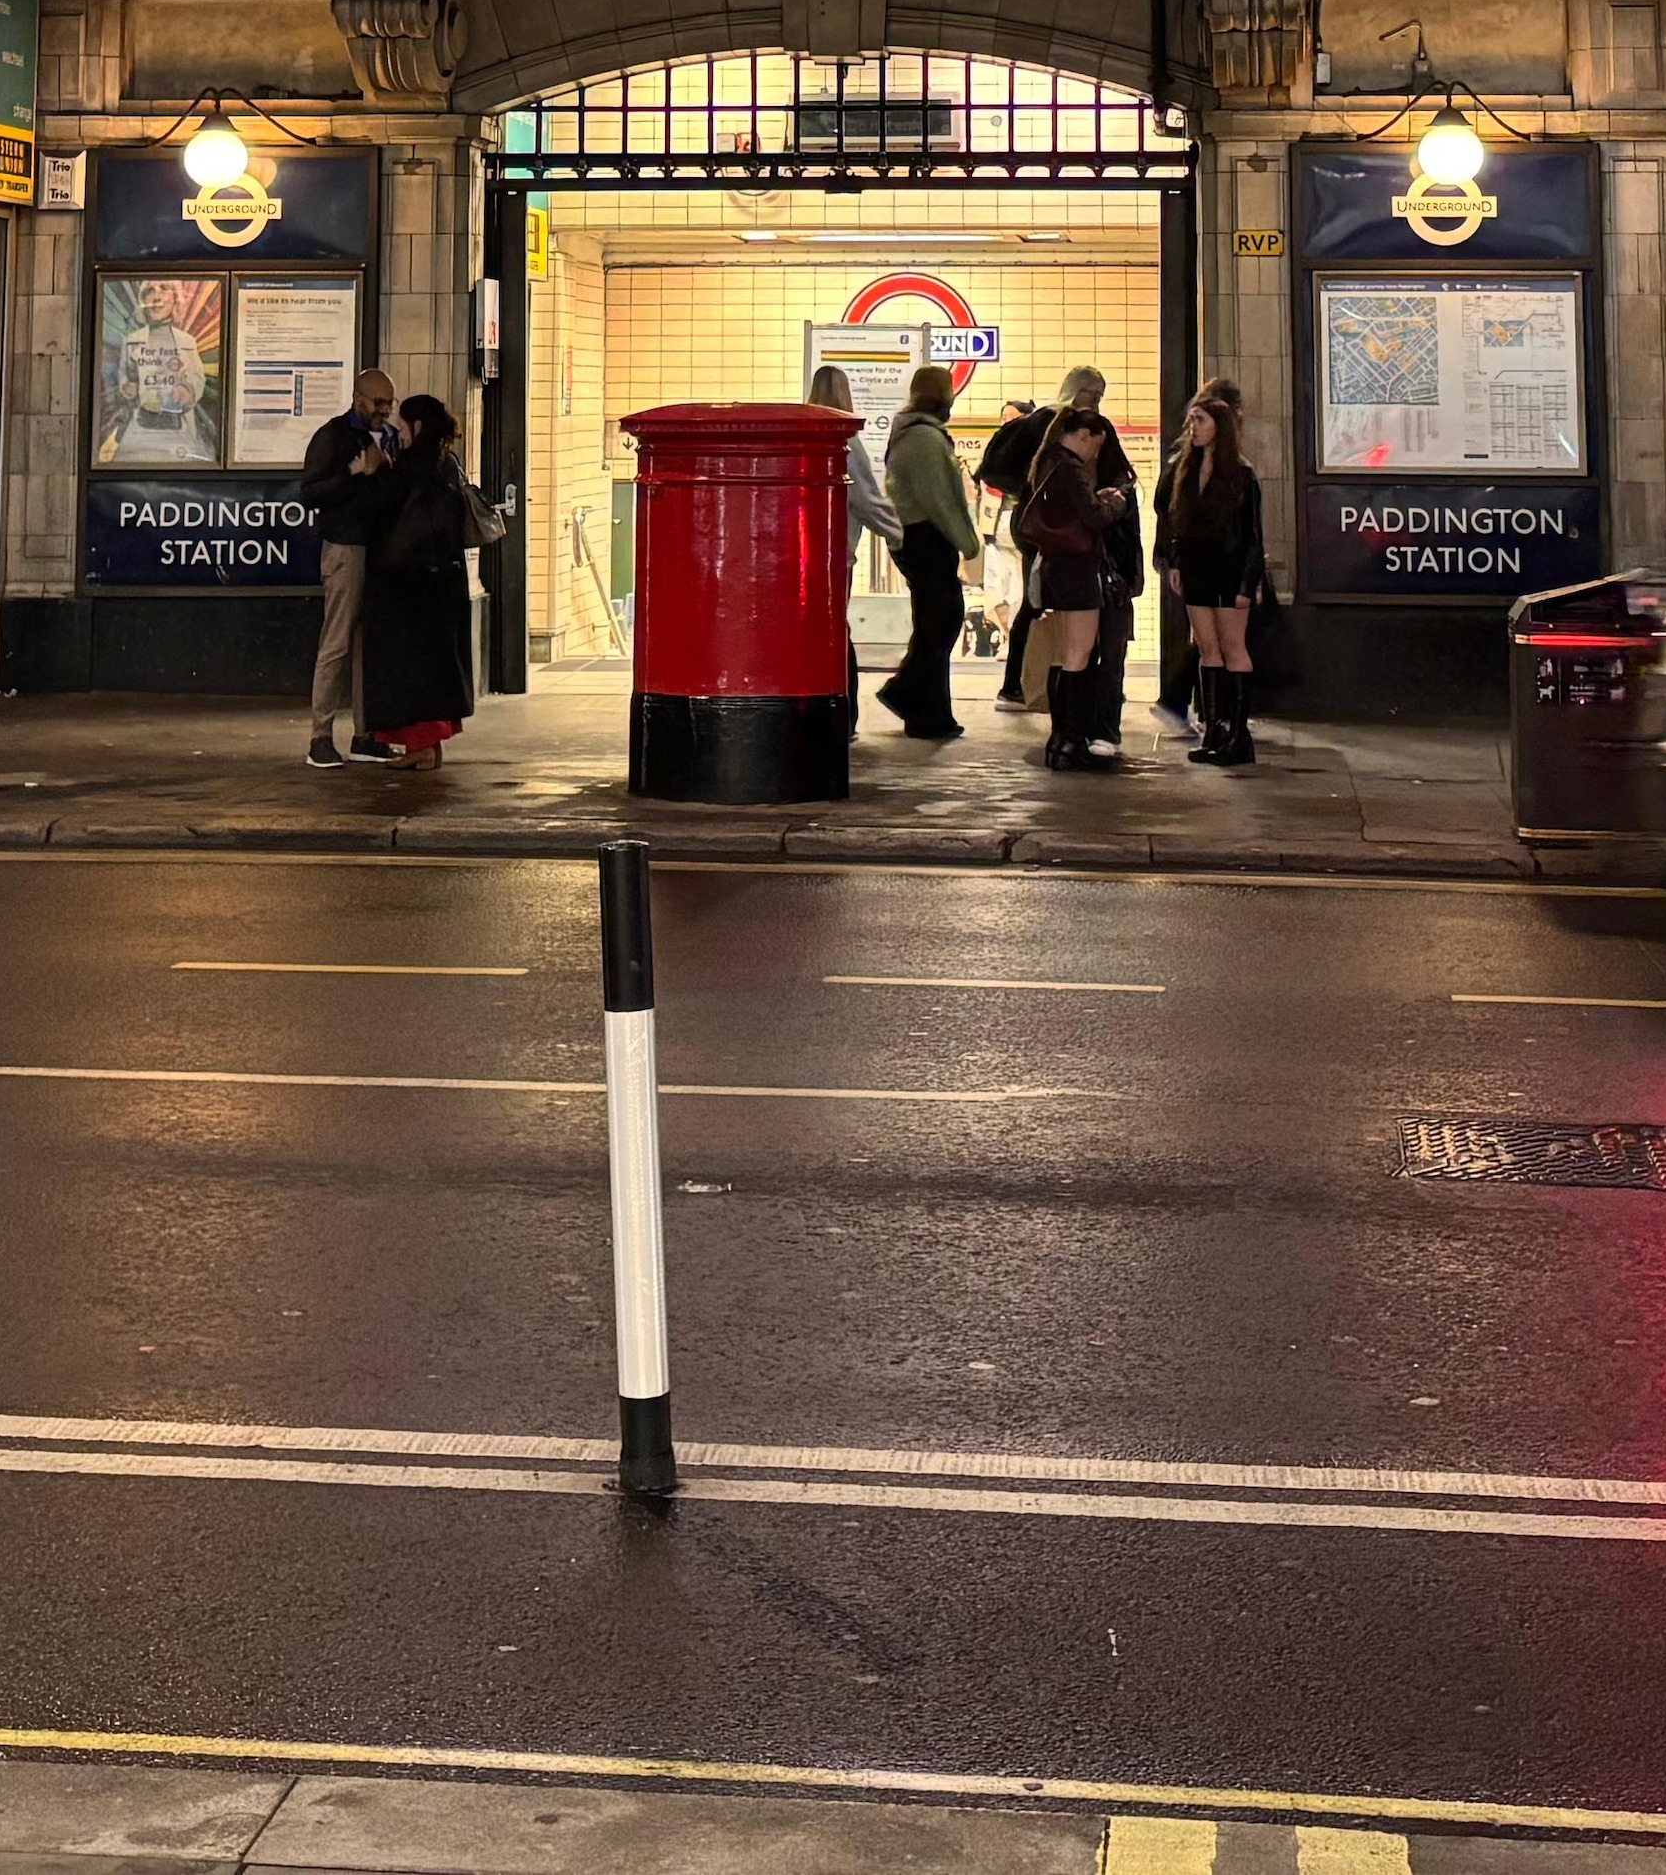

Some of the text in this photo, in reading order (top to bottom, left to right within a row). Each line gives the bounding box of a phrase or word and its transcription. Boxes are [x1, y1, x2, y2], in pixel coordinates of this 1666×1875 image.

[0, 155, 24, 174] UNION
[50, 160, 71, 172] Trio
[49, 188, 70, 200] Trio
[186, 203, 277, 215] UNDERGROUND
[1397, 200, 1492, 213] UNDERGROUND
[1238, 234, 1279, 251] RVP
[141, 346, 179, 356] For fast
[137, 356, 162, 366] think
[1340, 506, 1564, 535] PADDINGTON
[160, 539, 288, 565] STATION
[1385, 546, 1521, 573] STATION
